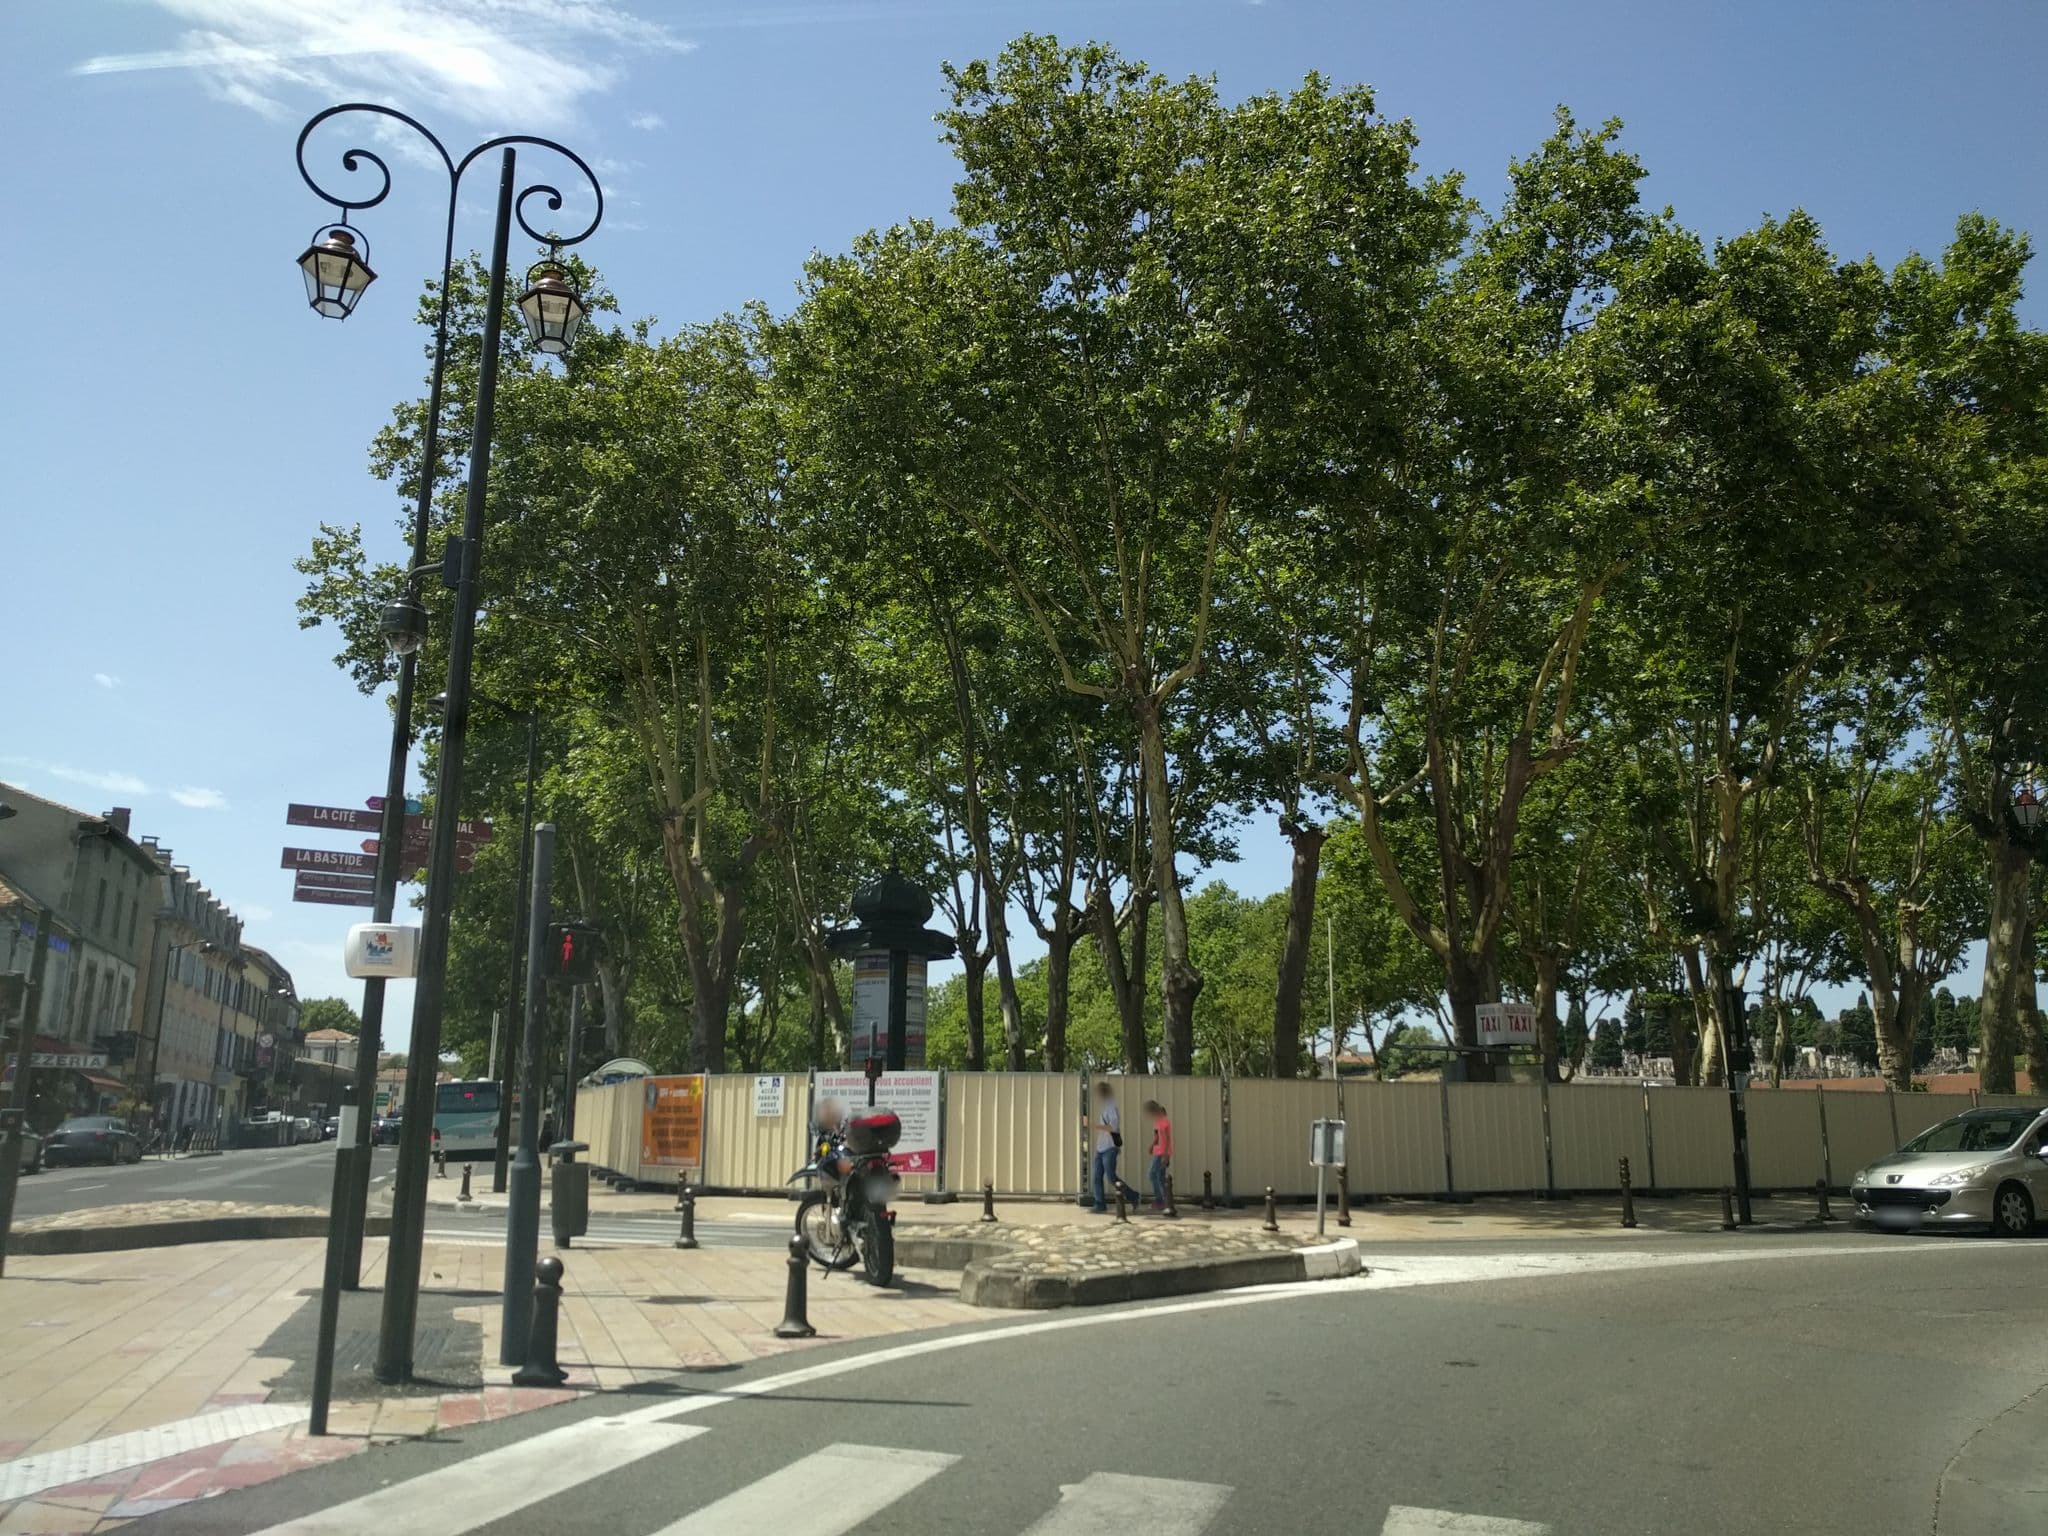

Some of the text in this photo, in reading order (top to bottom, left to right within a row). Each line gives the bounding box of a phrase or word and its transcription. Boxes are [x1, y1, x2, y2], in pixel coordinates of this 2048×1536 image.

[313, 808, 327, 821] LA
[296, 850, 363, 867] LA BASTIDE
[1480, 1015, 1501, 1032] TAXI
[1508, 1015, 1532, 1032] TAXI
[8, 1054, 101, 1067] PZZERIA
